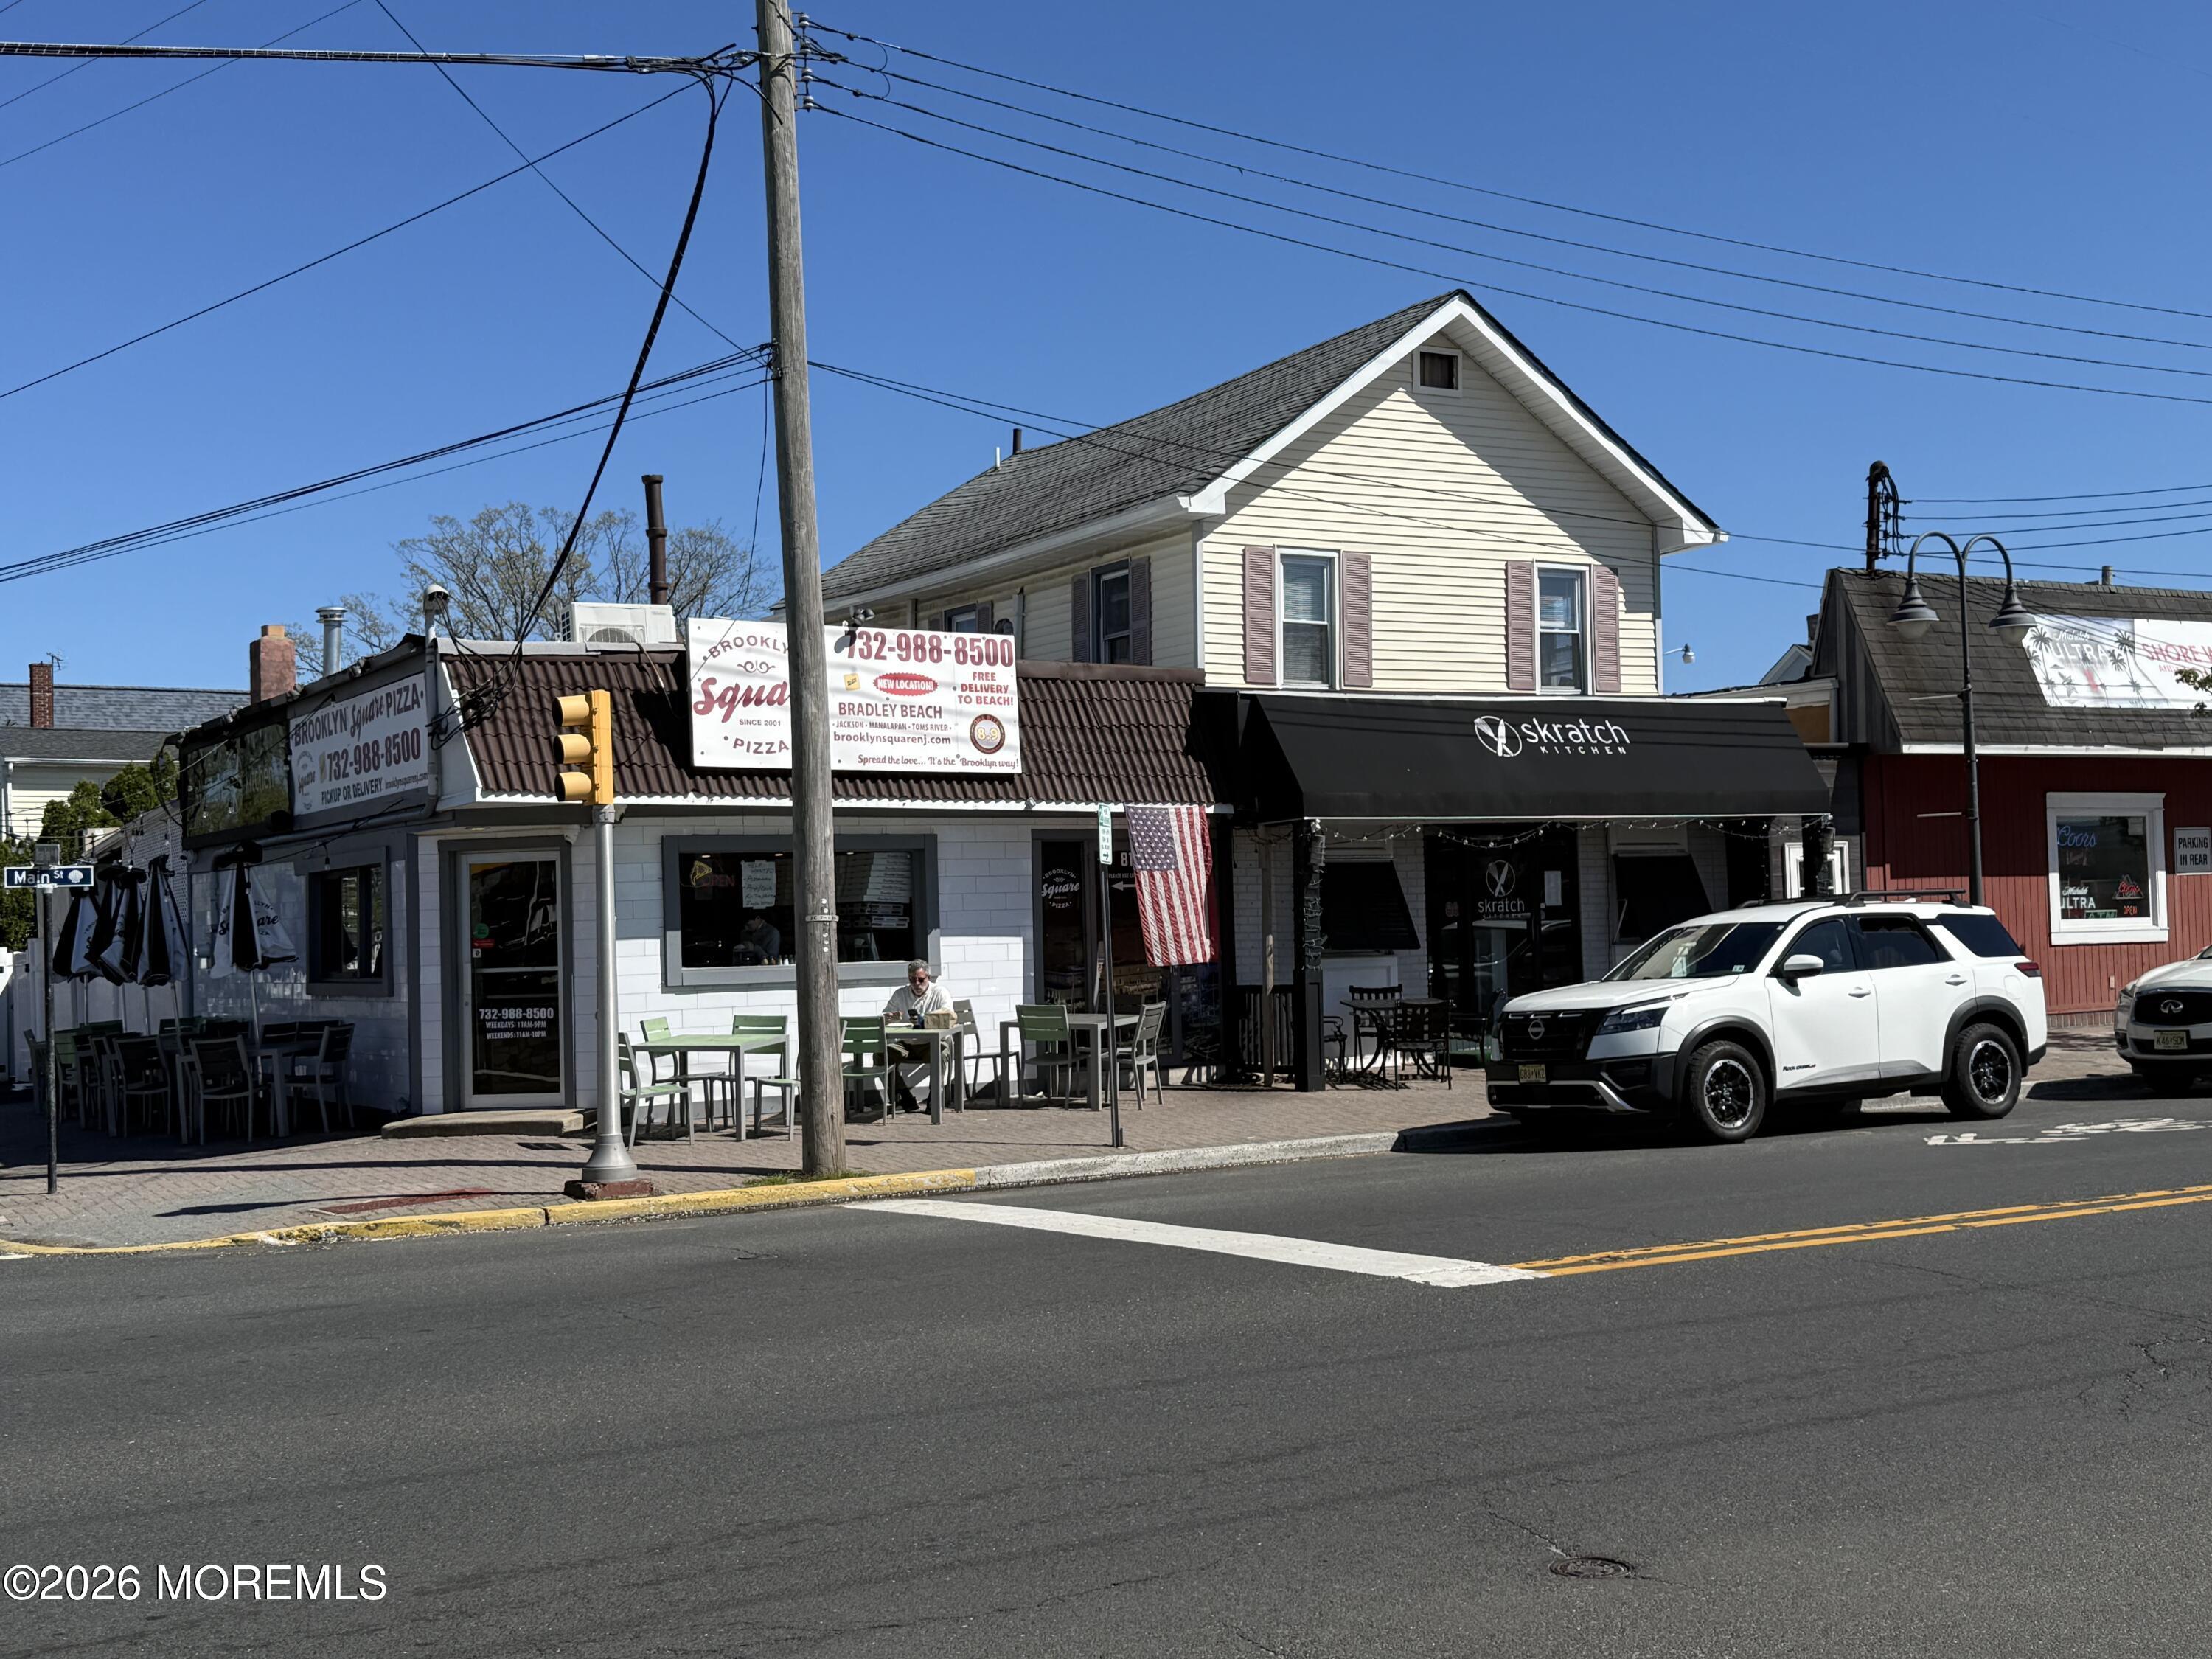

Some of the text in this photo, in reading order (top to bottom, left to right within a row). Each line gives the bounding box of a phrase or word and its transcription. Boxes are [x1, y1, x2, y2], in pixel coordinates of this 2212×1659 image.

[708, 635, 789, 659] BROOKLY
[2049, 642, 2111, 661] ULTRA
[2141, 644, 2202, 663] SHORE
[973, 671, 996, 681] FREE
[877, 679, 934, 690] NEW LOCATION!
[960, 683, 1009, 694] DELIVERY
[693, 677, 790, 723] Squa
[958, 695, 1014, 706] TO BEACH!
[838, 702, 942, 719] BRADLEY BEACH
[295, 706, 348, 747] BROOKLYN
[350, 695, 385, 742] Square
[836, 720, 864, 728] JACKSON
[869, 721, 907, 730] MANALAPAN
[912, 723, 929, 731] TOMS
[977, 727, 999, 741] 8.9
[1520, 717, 1630, 744] skratch
[833, 731, 951, 745] brooklynsquarenj.com
[733, 737, 790, 754] PIZZA
[1540, 746, 1627, 754] KITCHEN
[327, 727, 421, 782] 732-988-8500
[858, 754, 1019, 769] Spread the love... It's the Brooklyn way!
[321, 786, 341, 805] PICKUP
[343, 785, 352, 801] OR
[352, 777, 383, 799] DELIVERY
[2057, 825, 2097, 847] Coors
[2178, 837, 2208, 849] PARKING
[2180, 854, 2208, 866] IN REAR
[15, 871, 63, 885] Main St
[1044, 869, 1074, 878] BROOKLYN
[1040, 883, 1080, 899] Square
[1478, 898, 1525, 913] skratch
[2123, 905, 2138, 915] OPEN
[479, 1007, 554, 1020] 732-988-8500
[487, 1032, 516, 1040] WEEKENDS:
